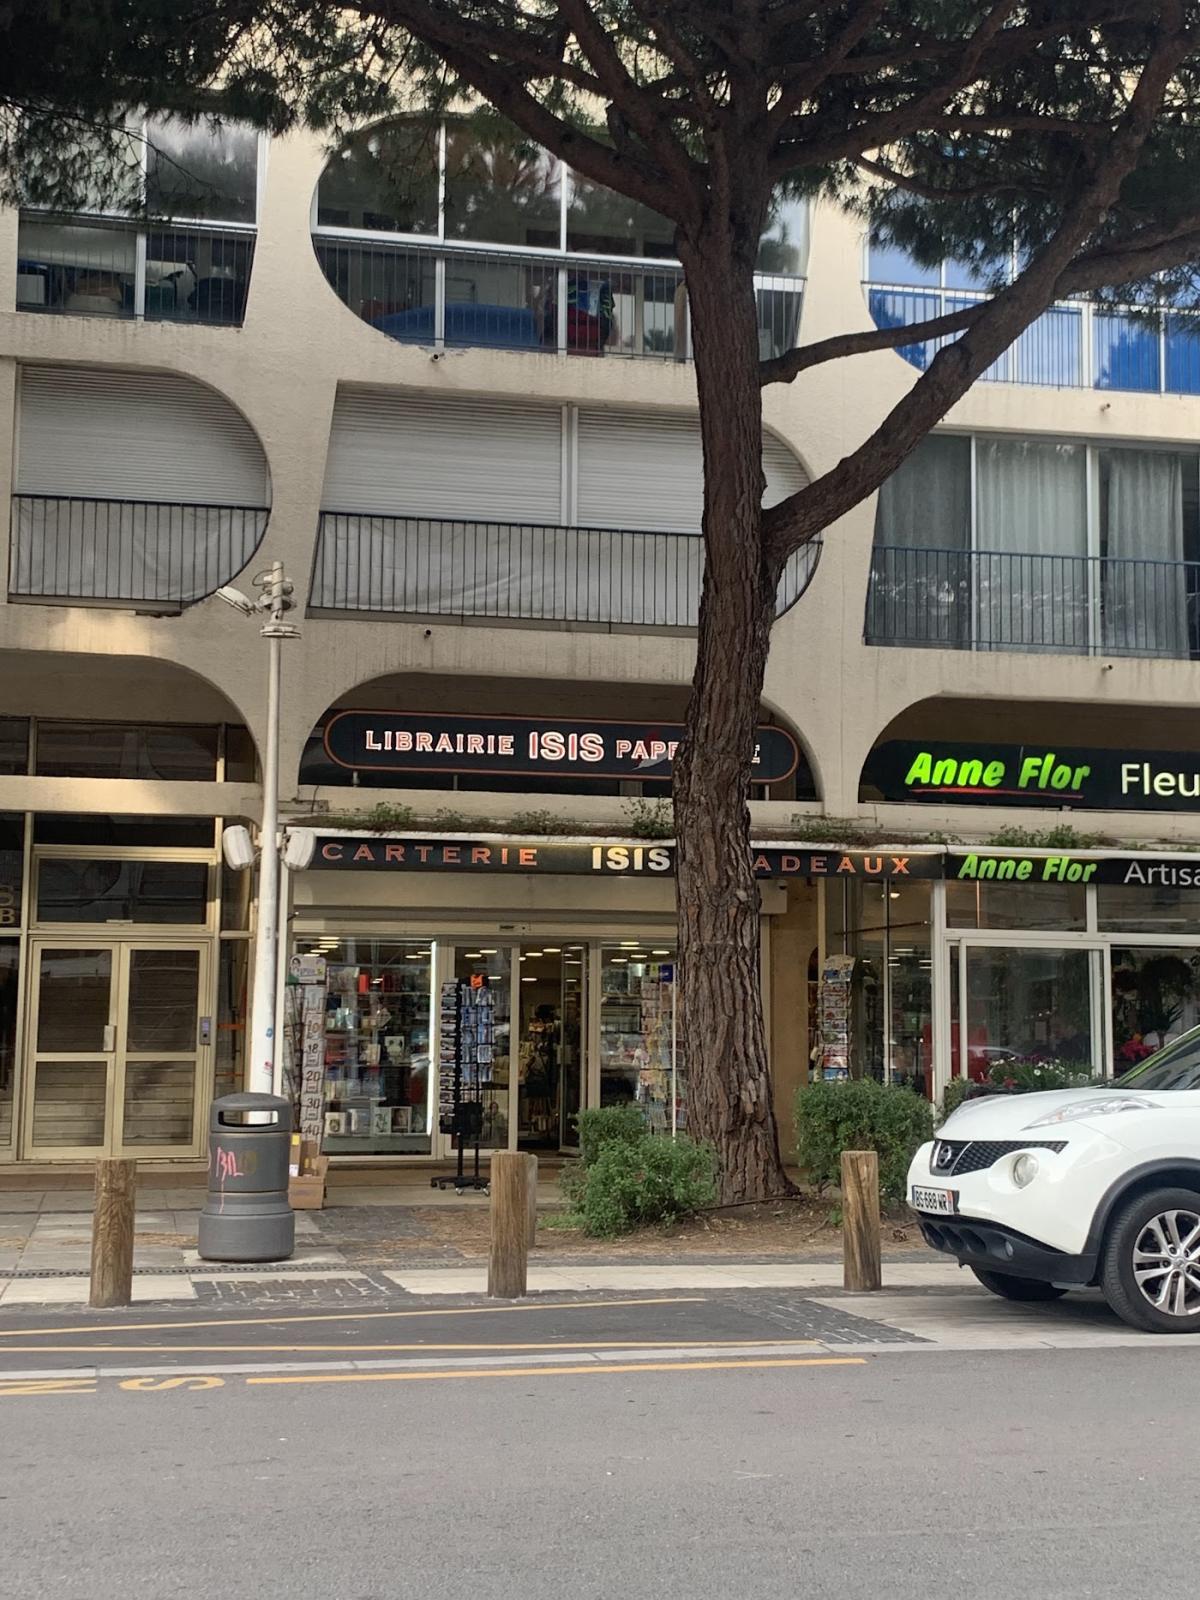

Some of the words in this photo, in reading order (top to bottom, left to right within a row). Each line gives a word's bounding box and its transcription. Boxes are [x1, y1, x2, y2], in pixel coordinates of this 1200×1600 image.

[365, 730, 515, 755] LIBRAIRIE
[529, 731, 605, 762] ISIS
[905, 752, 1006, 787] Anne
[1019, 753, 1091, 791] Flor
[321, 843, 538, 866] CARTERIE
[592, 846, 671, 872] ISIS
[752, 855, 910, 875] ADEAUX
[957, 853, 1033, 880] Anne
[1042, 856, 1098, 882] Flor
[306, 1071, 320, 1082] 20
[307, 1098, 320, 1109] 30
